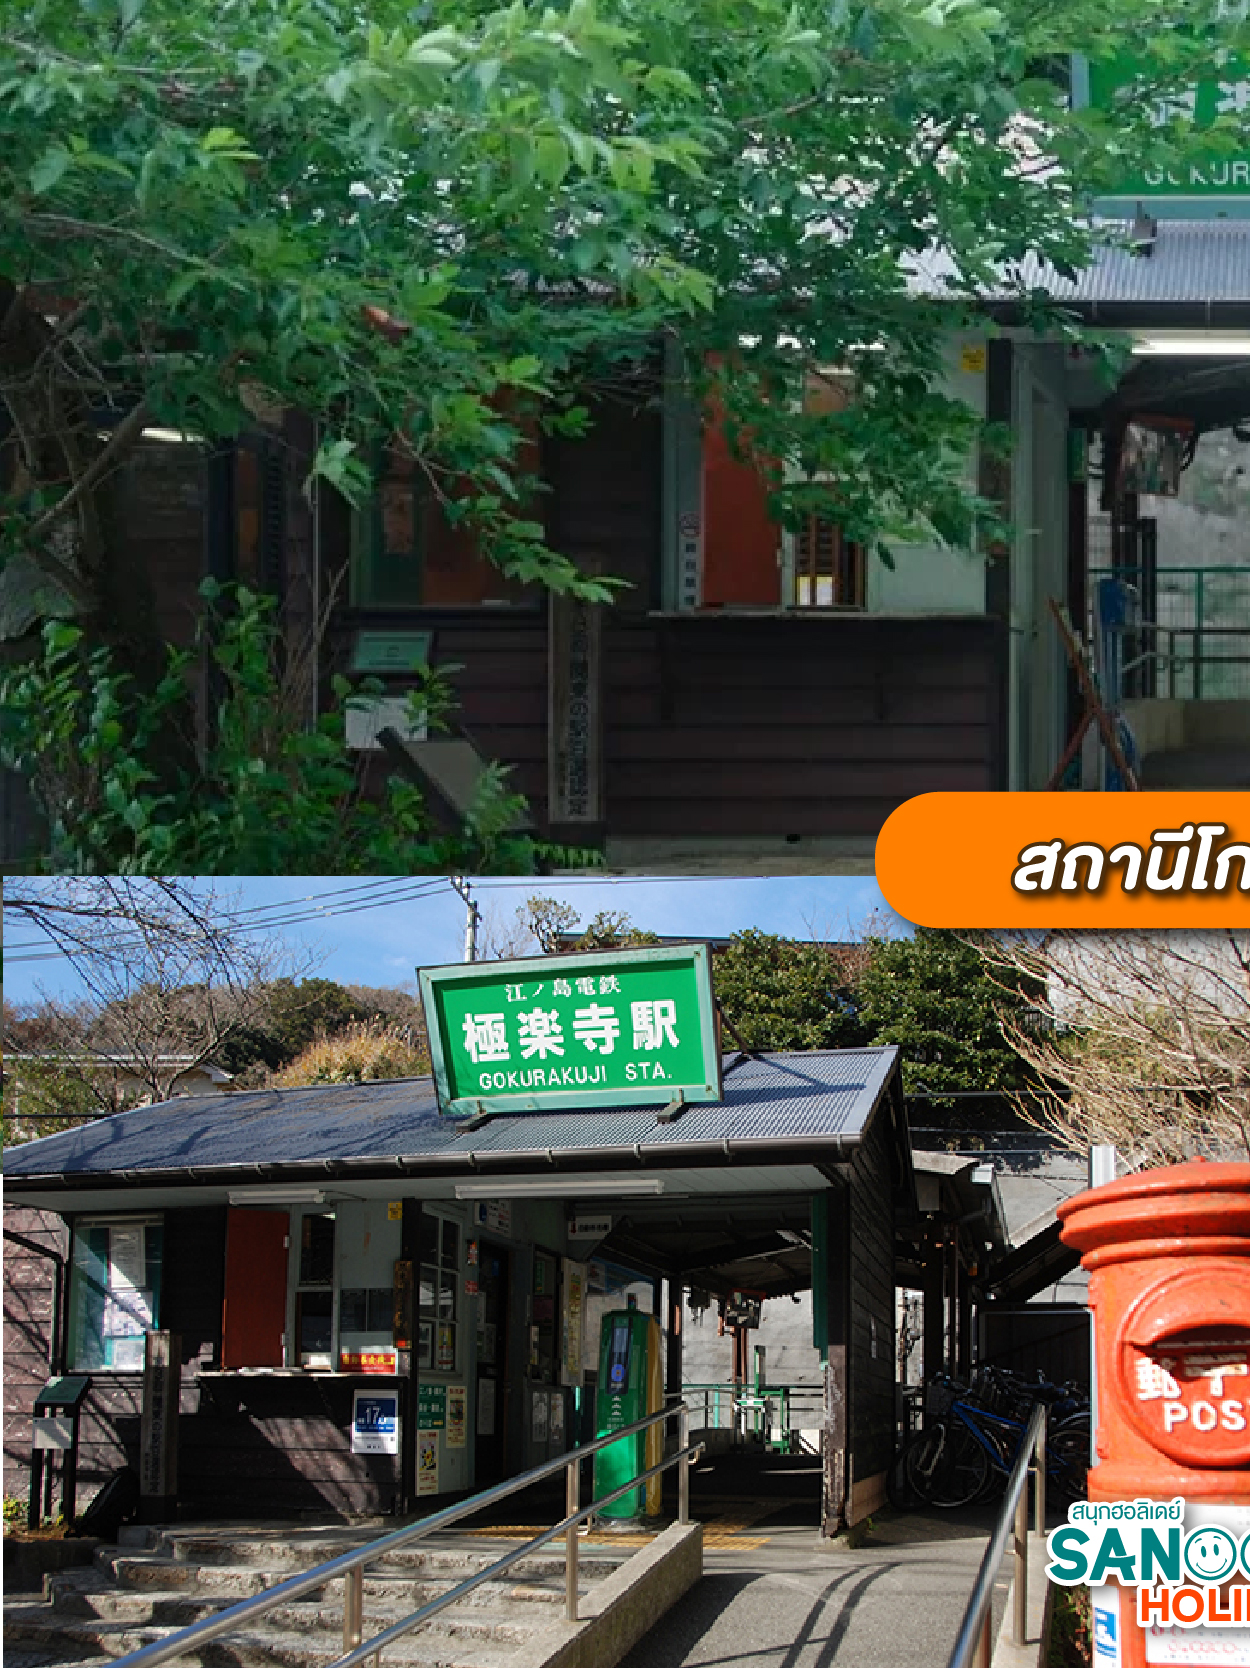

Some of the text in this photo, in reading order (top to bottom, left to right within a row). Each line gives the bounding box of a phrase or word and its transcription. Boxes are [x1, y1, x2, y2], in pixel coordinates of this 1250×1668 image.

[504, 974, 622, 1003] 江ノ島電鉄
[461, 999, 681, 1064] 極楽寺駅
[478, 1061, 673, 1091] GOKURAKUJI STA.
